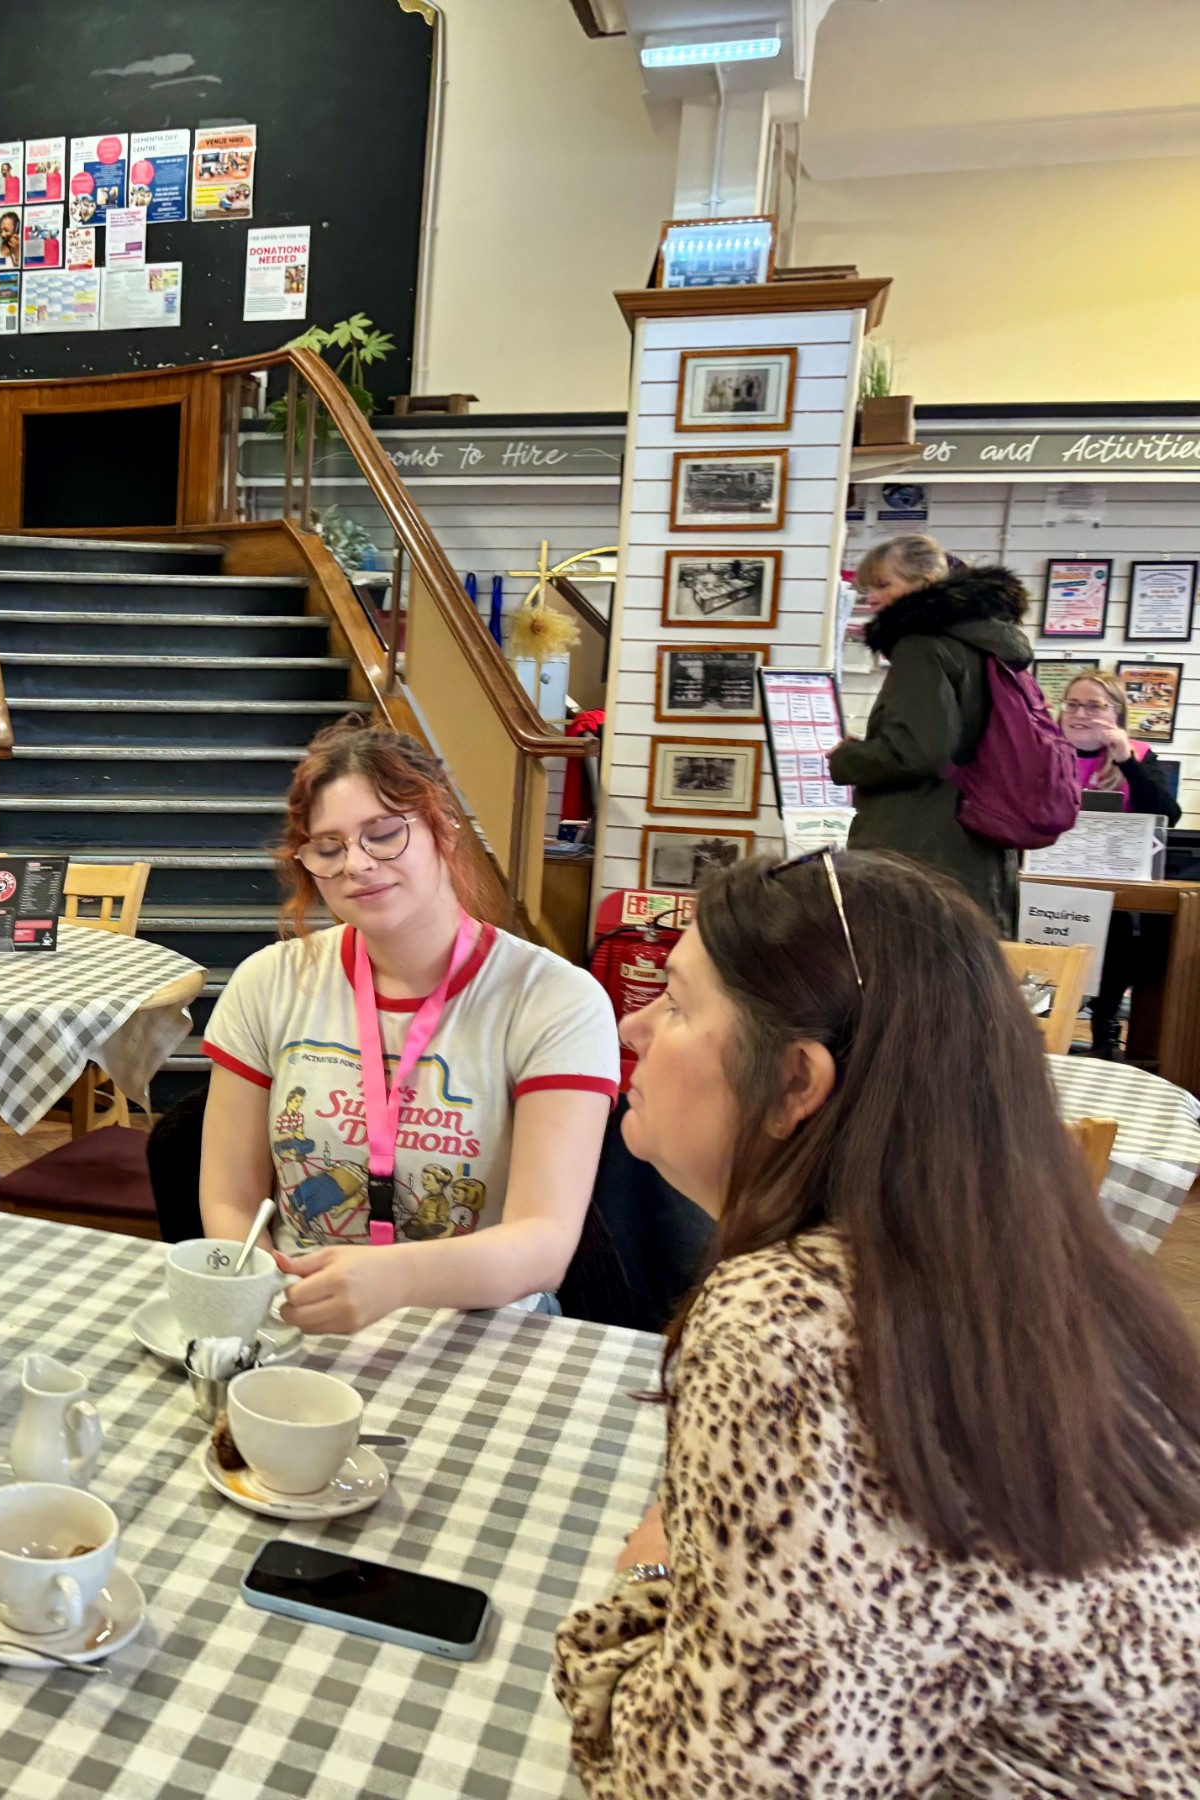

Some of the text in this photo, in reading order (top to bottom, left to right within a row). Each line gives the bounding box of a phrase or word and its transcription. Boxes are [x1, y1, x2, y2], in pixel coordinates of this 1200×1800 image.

[133, 136, 164, 144] DEMENTIA
[133, 145, 157, 153] CENTRE
[249, 245, 307, 256] DONATIONS
[258, 255, 297, 264] NEEDED
[458, 442, 486, 469] to
[502, 442, 568, 467] Hire
[980, 435, 1040, 463] and
[1062, 434, 1200, 463] Activitie
[1028, 906, 1091, 923] Enquiries
[1043, 926, 1070, 936] and
[302, 1053, 355, 1068] ACTIVITIES FOR
[314, 1089, 474, 1137] Sumon
[338, 1119, 481, 1159] Dmons
